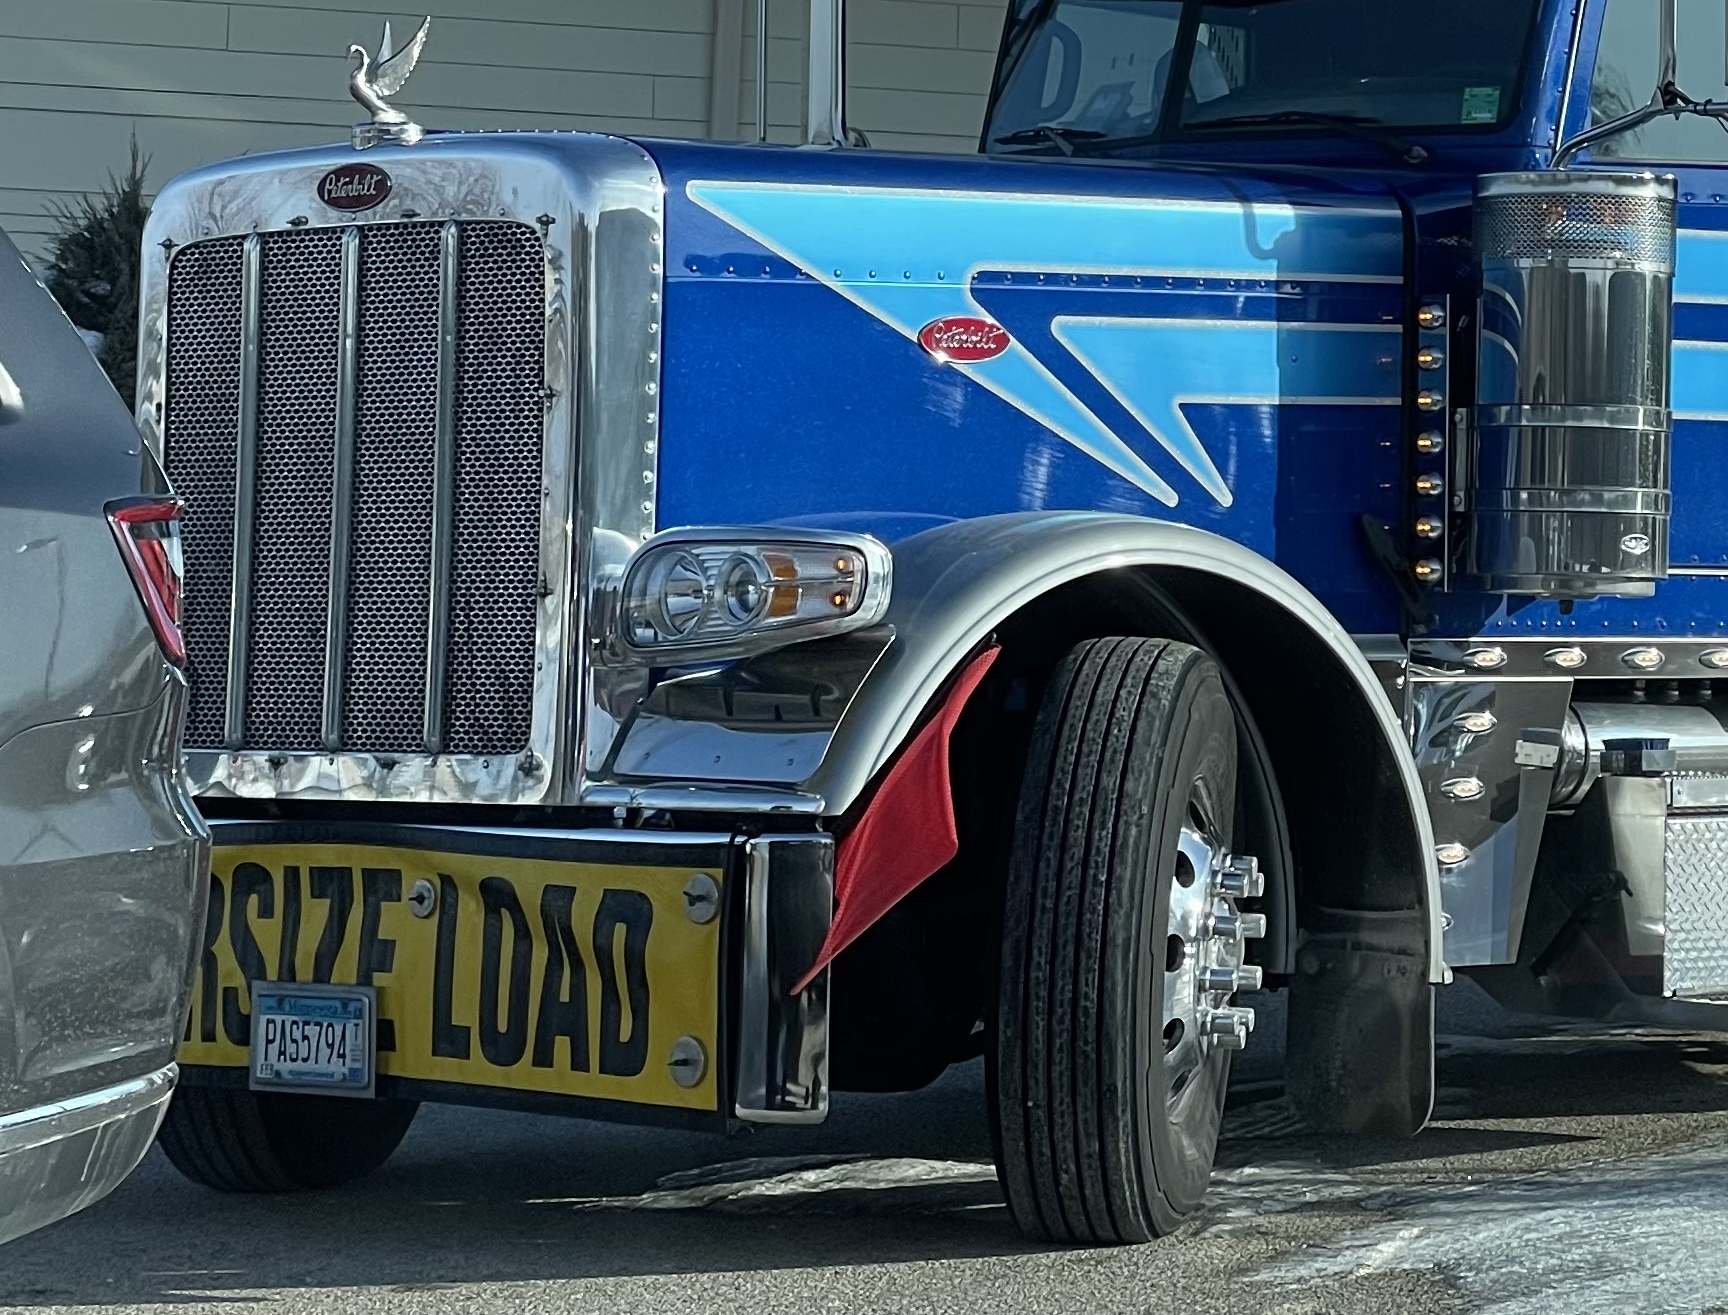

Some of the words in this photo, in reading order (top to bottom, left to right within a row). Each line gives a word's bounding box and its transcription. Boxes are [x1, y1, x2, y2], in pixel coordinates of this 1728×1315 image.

[324, 173, 382, 201] Peterbilt
[432, 872, 654, 1077] LOAD
[264, 1018, 347, 1067] PAS5794
